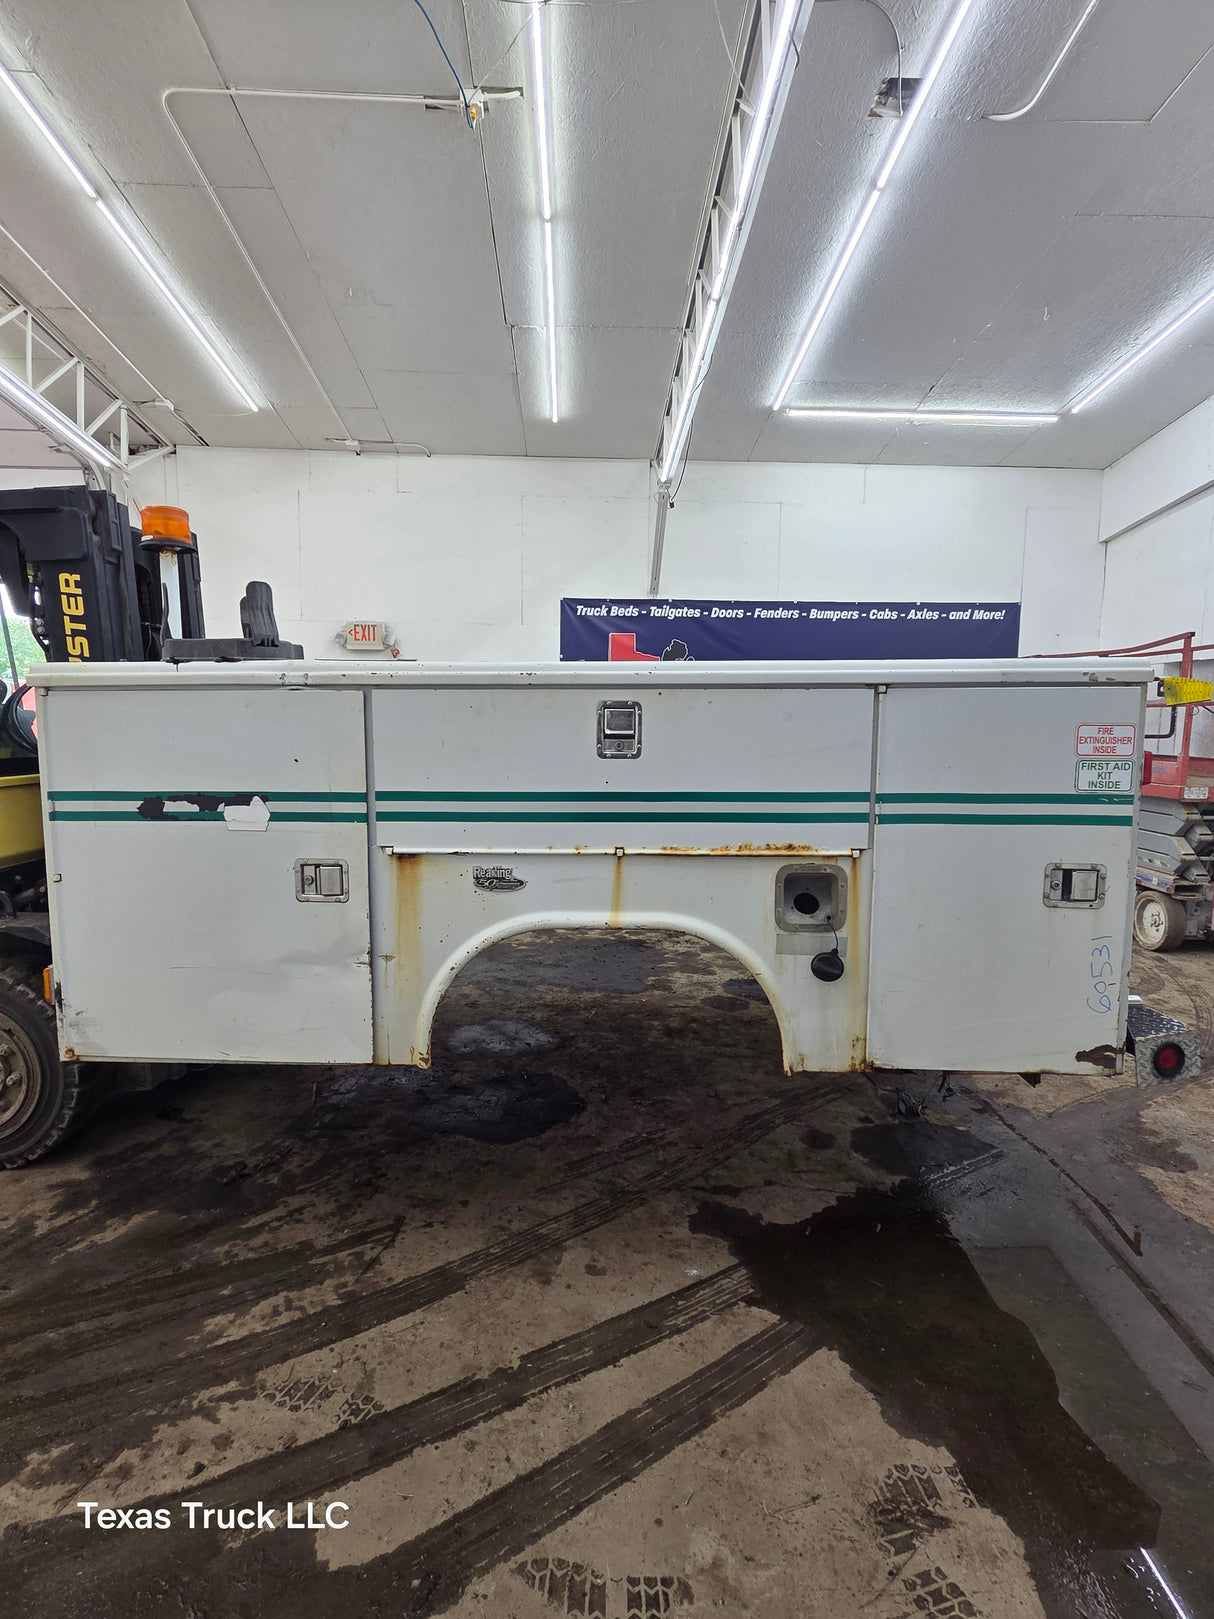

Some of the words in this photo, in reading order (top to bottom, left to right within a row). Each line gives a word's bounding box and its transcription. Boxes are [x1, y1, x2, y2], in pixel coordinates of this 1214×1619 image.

[576, 605, 608, 616] Truck
[610, 605, 639, 617] Beds
[649, 606, 701, 620] Tailgates
[710, 607, 745, 618] Doors
[753, 608, 799, 619] Fenders
[809, 608, 859, 621] Bumpers
[869, 609, 898, 620] Cabs
[907, 609, 939, 620] Axles
[948, 609, 971, 620] and
[972, 609, 1006, 620] More!
[353, 624, 377, 641] EXIT
[1098, 727, 1114, 735] FIRE
[1097, 772, 1113, 780] KIT
[1088, 781, 1121, 789] INSIDE
[473, 866, 513, 880] Reading
[1087, 935, 1113, 1014] 60531
